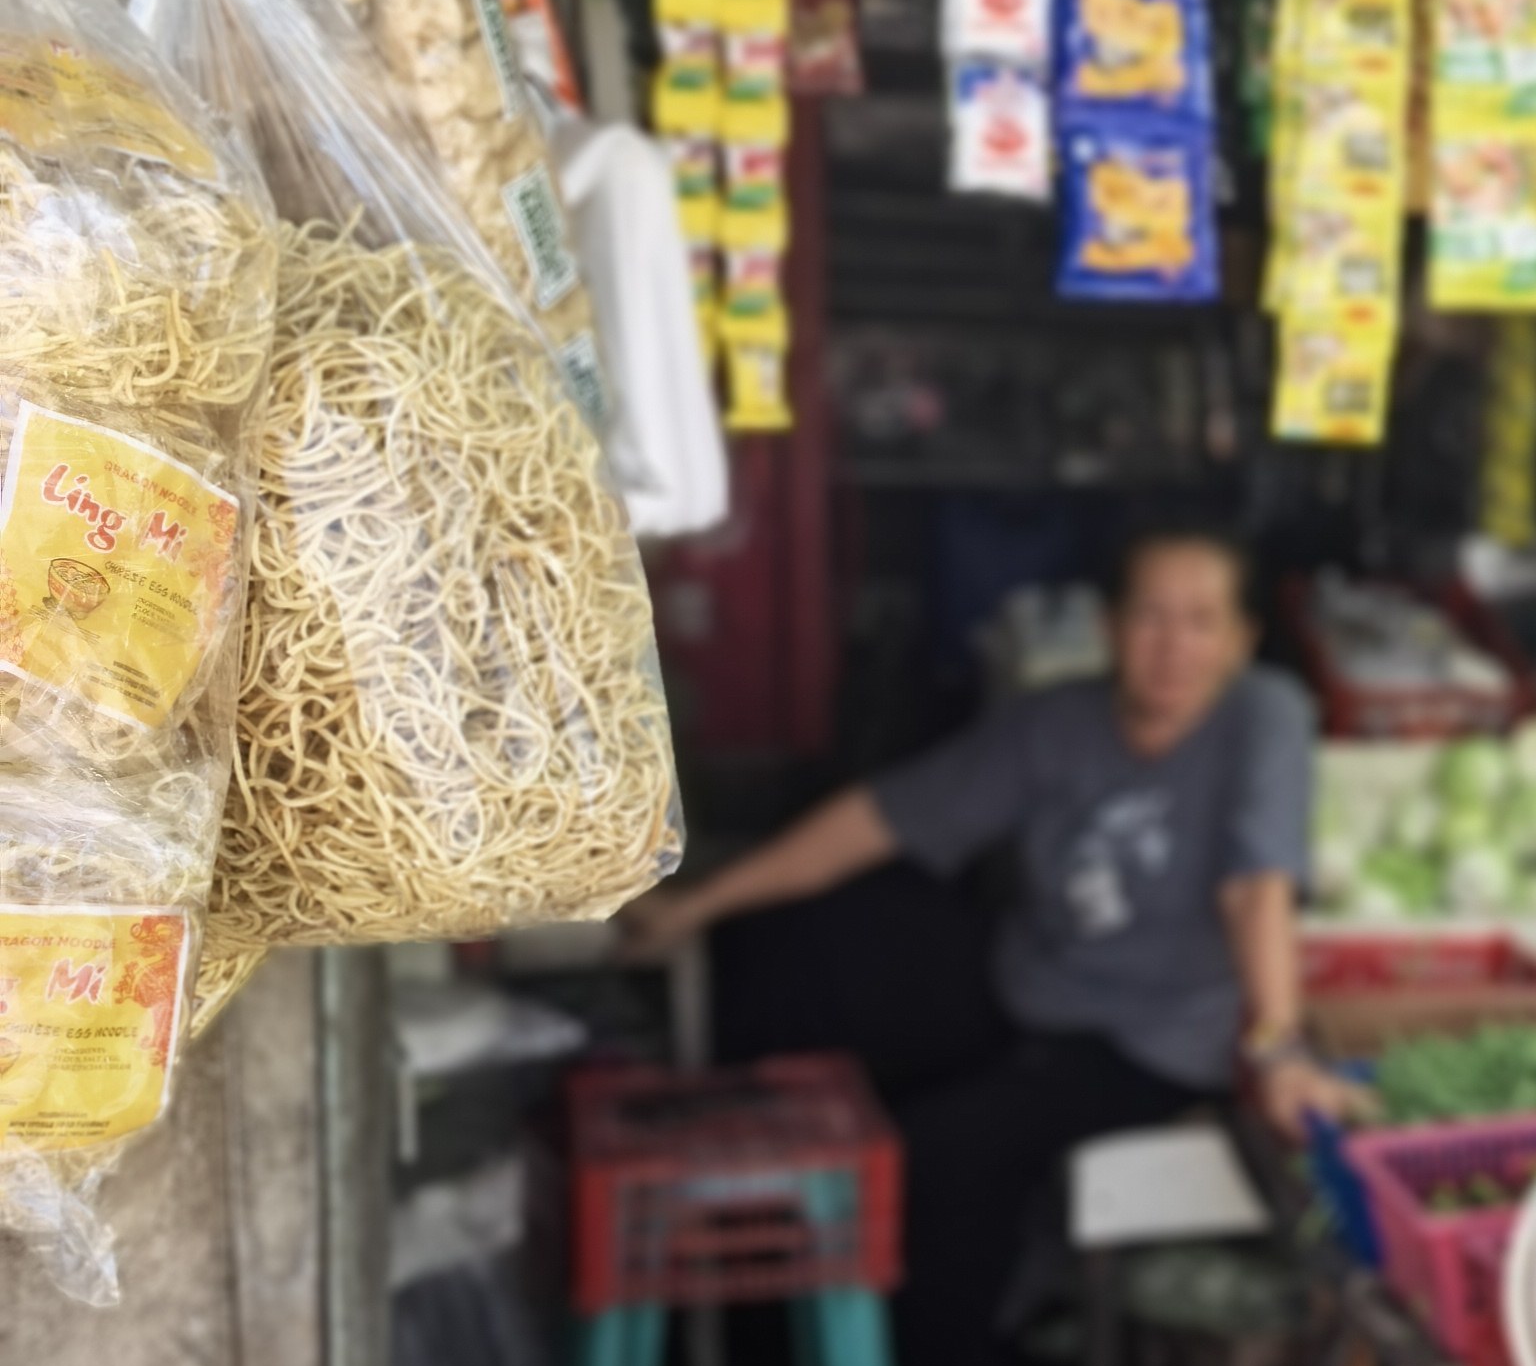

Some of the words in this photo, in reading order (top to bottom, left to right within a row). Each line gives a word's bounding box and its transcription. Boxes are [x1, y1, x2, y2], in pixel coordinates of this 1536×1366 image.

[43, 464, 127, 552] Ling
[139, 511, 188, 563] Mi
[46, 957, 107, 1003] Mi
[66, 1027, 93, 1039] EGG
